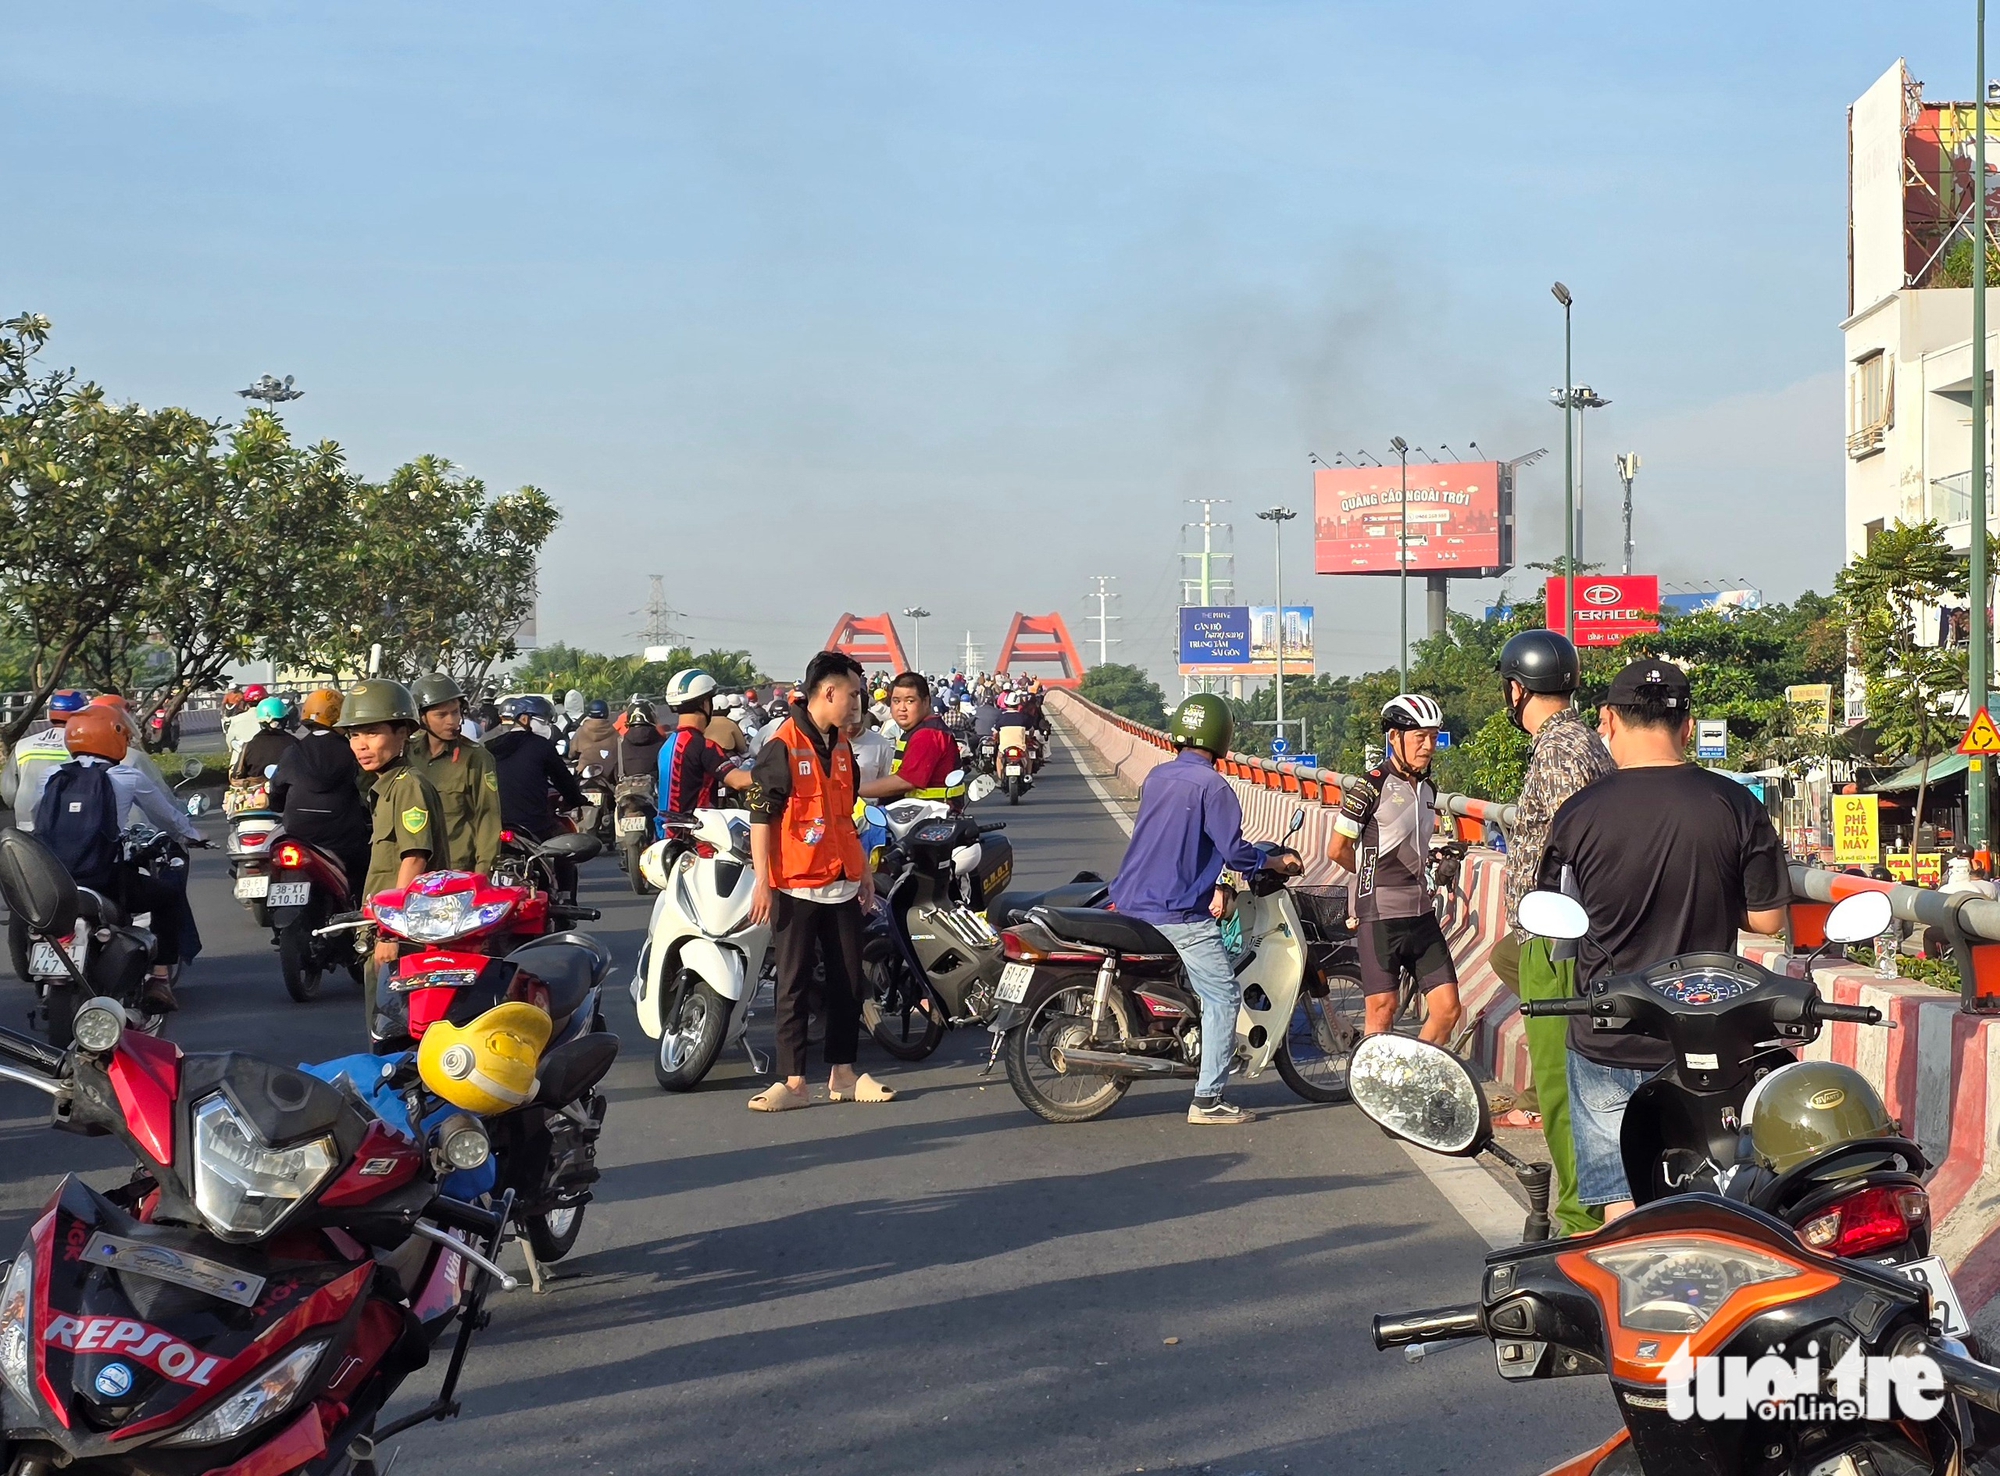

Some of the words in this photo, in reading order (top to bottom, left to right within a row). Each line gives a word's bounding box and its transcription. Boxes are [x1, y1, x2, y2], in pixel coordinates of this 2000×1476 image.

[1380, 487, 1403, 504] CÁO
[1405, 487, 1440, 502] NGOÀI
[1442, 490, 1470, 506] TRỜI
[1846, 799, 1865, 811] CÀ
[1845, 812, 1867, 825] PHÊ
[1844, 825, 1868, 837] PHA
[1843, 837, 1869, 850] MÁY
[1888, 860, 1911, 868] PHA
[276, 884, 304, 894] 38-X1
[270, 894, 306, 905] 510.16
[43, 1314, 219, 1386] REPSOL
